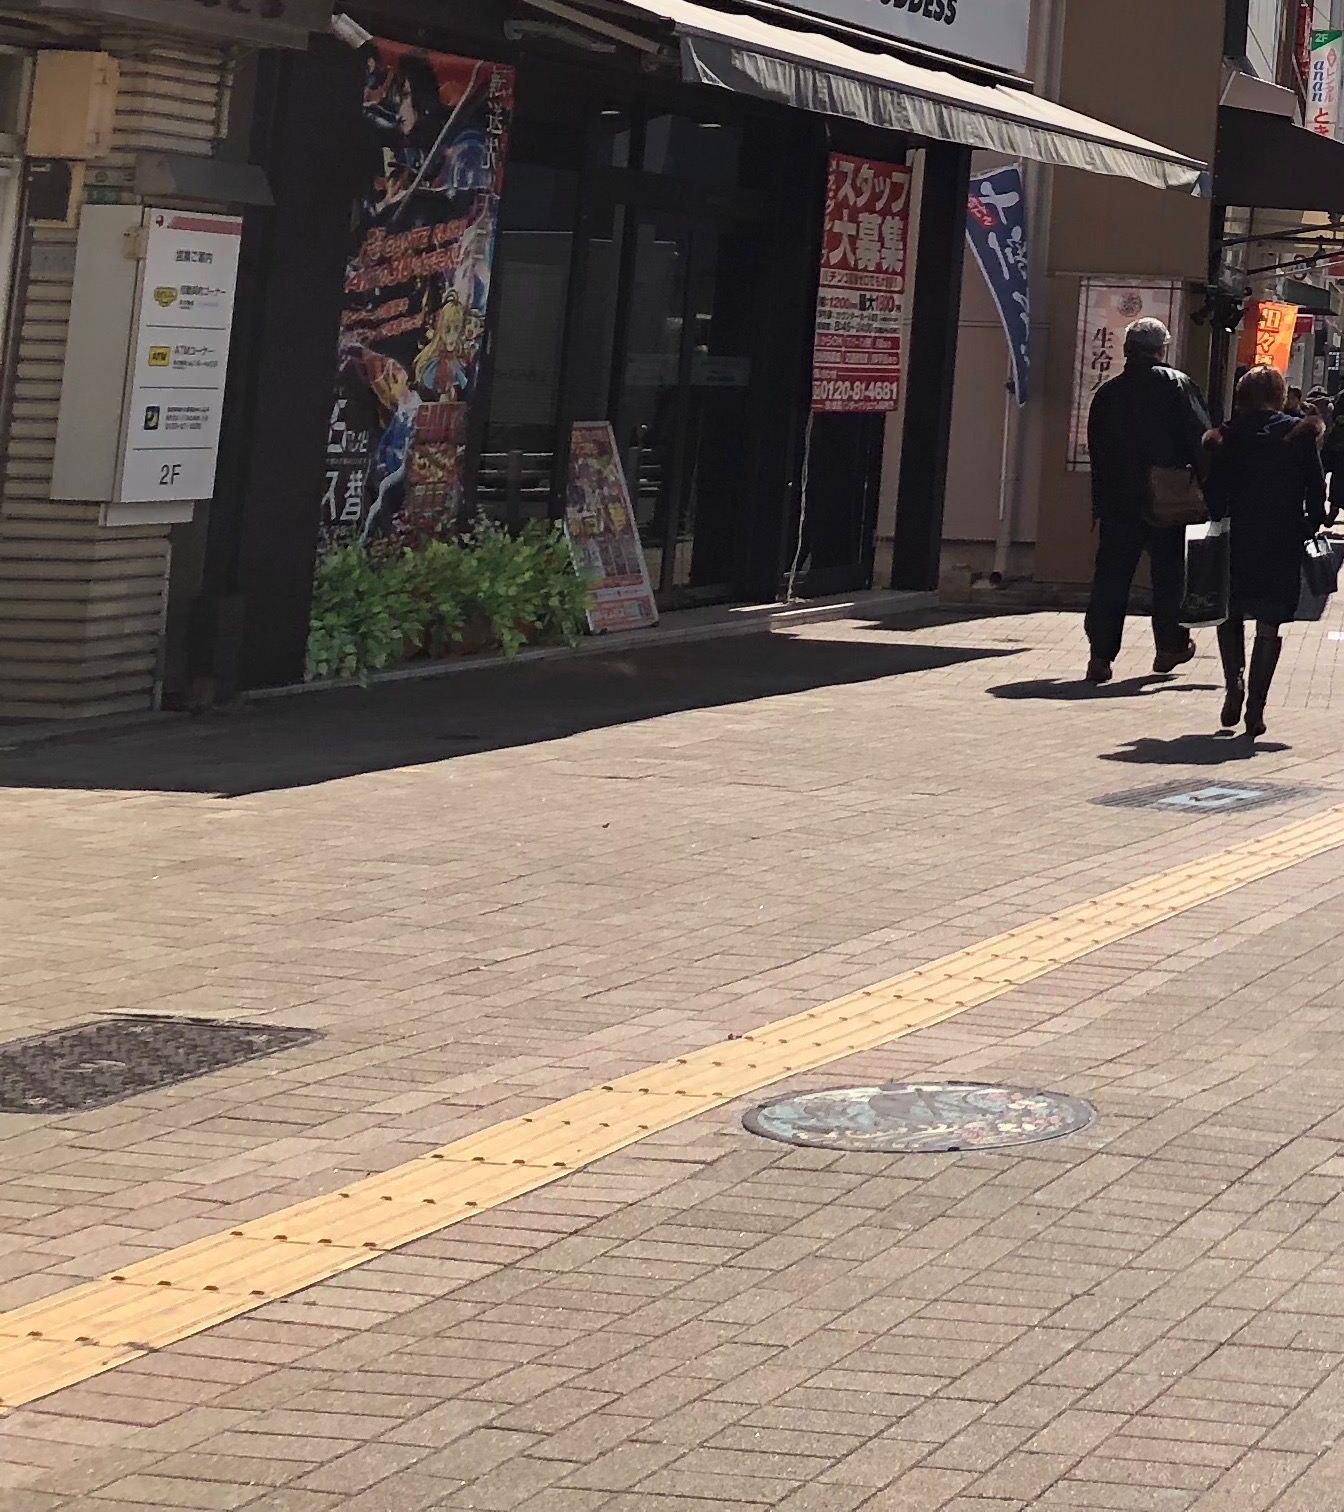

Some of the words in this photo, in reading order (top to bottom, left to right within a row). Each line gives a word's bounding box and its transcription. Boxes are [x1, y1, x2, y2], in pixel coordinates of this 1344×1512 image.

[1314, 33, 1329, 43] 2F
[1312, 60, 1325, 103] anan
[836, 160, 911, 214] スタッフ
[828, 208, 905, 273] 大募集
[159, 464, 182, 485] 2F
